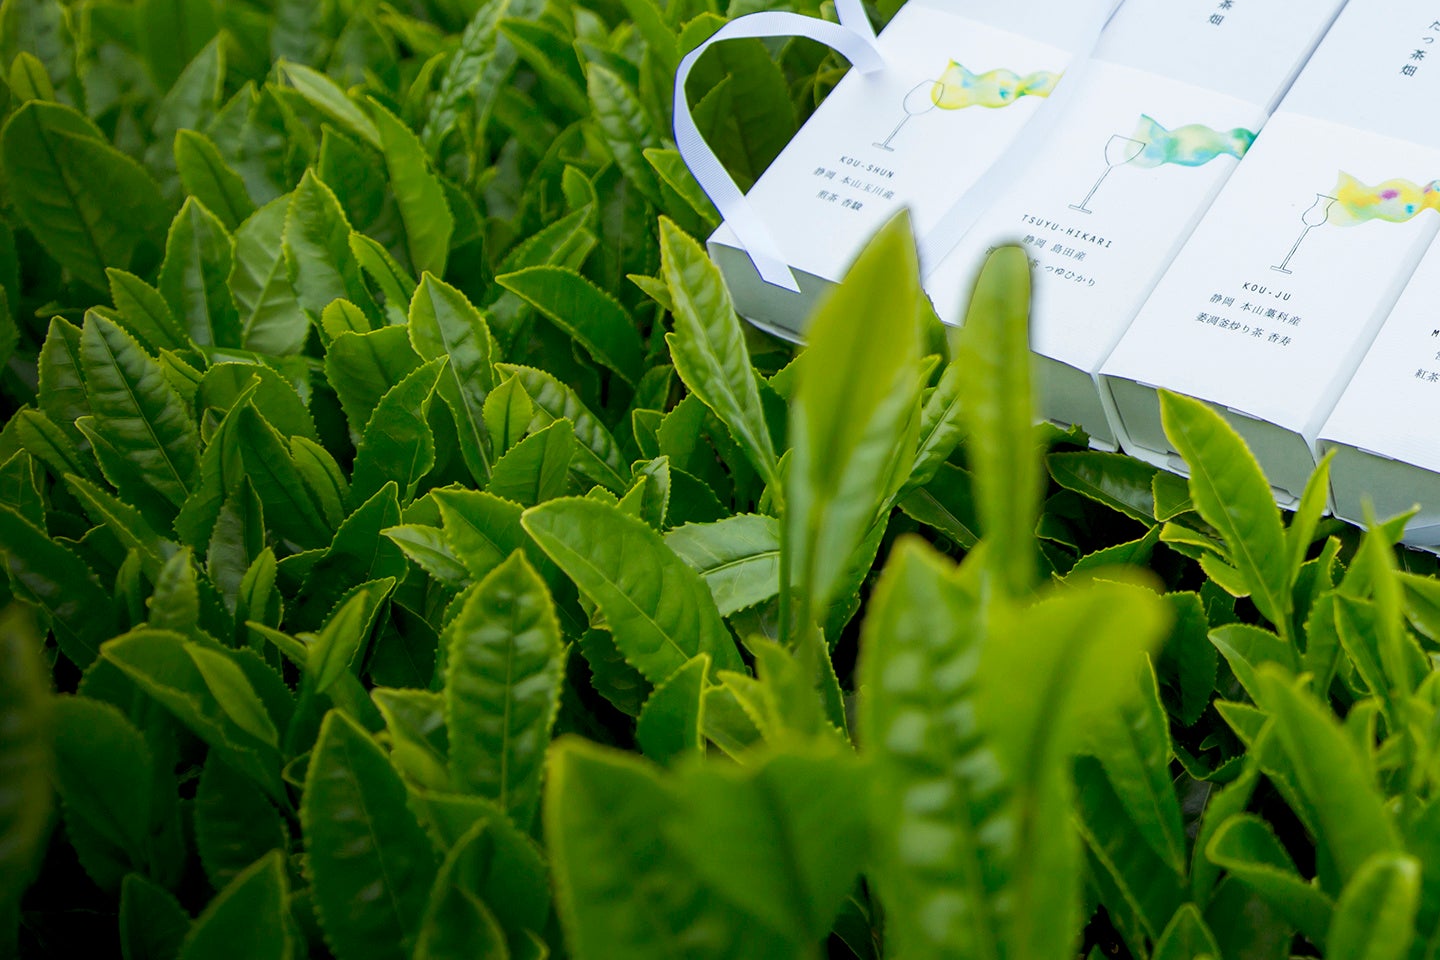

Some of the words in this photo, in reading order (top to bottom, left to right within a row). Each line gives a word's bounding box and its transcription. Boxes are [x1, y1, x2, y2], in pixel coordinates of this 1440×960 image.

[840, 155, 895, 178] KOU-SHUN
[1021, 214, 1112, 248] TSUYU-HIKARI
[1022, 234, 1047, 249] 静岡
[1050, 243, 1086, 262] 島田産
[1045, 265, 1096, 287] つゆひかり
[1209, 293, 1235, 307] 静岡
[1242, 282, 1291, 301] KOU-JU
[1415, 368, 1440, 382] 紅茶
